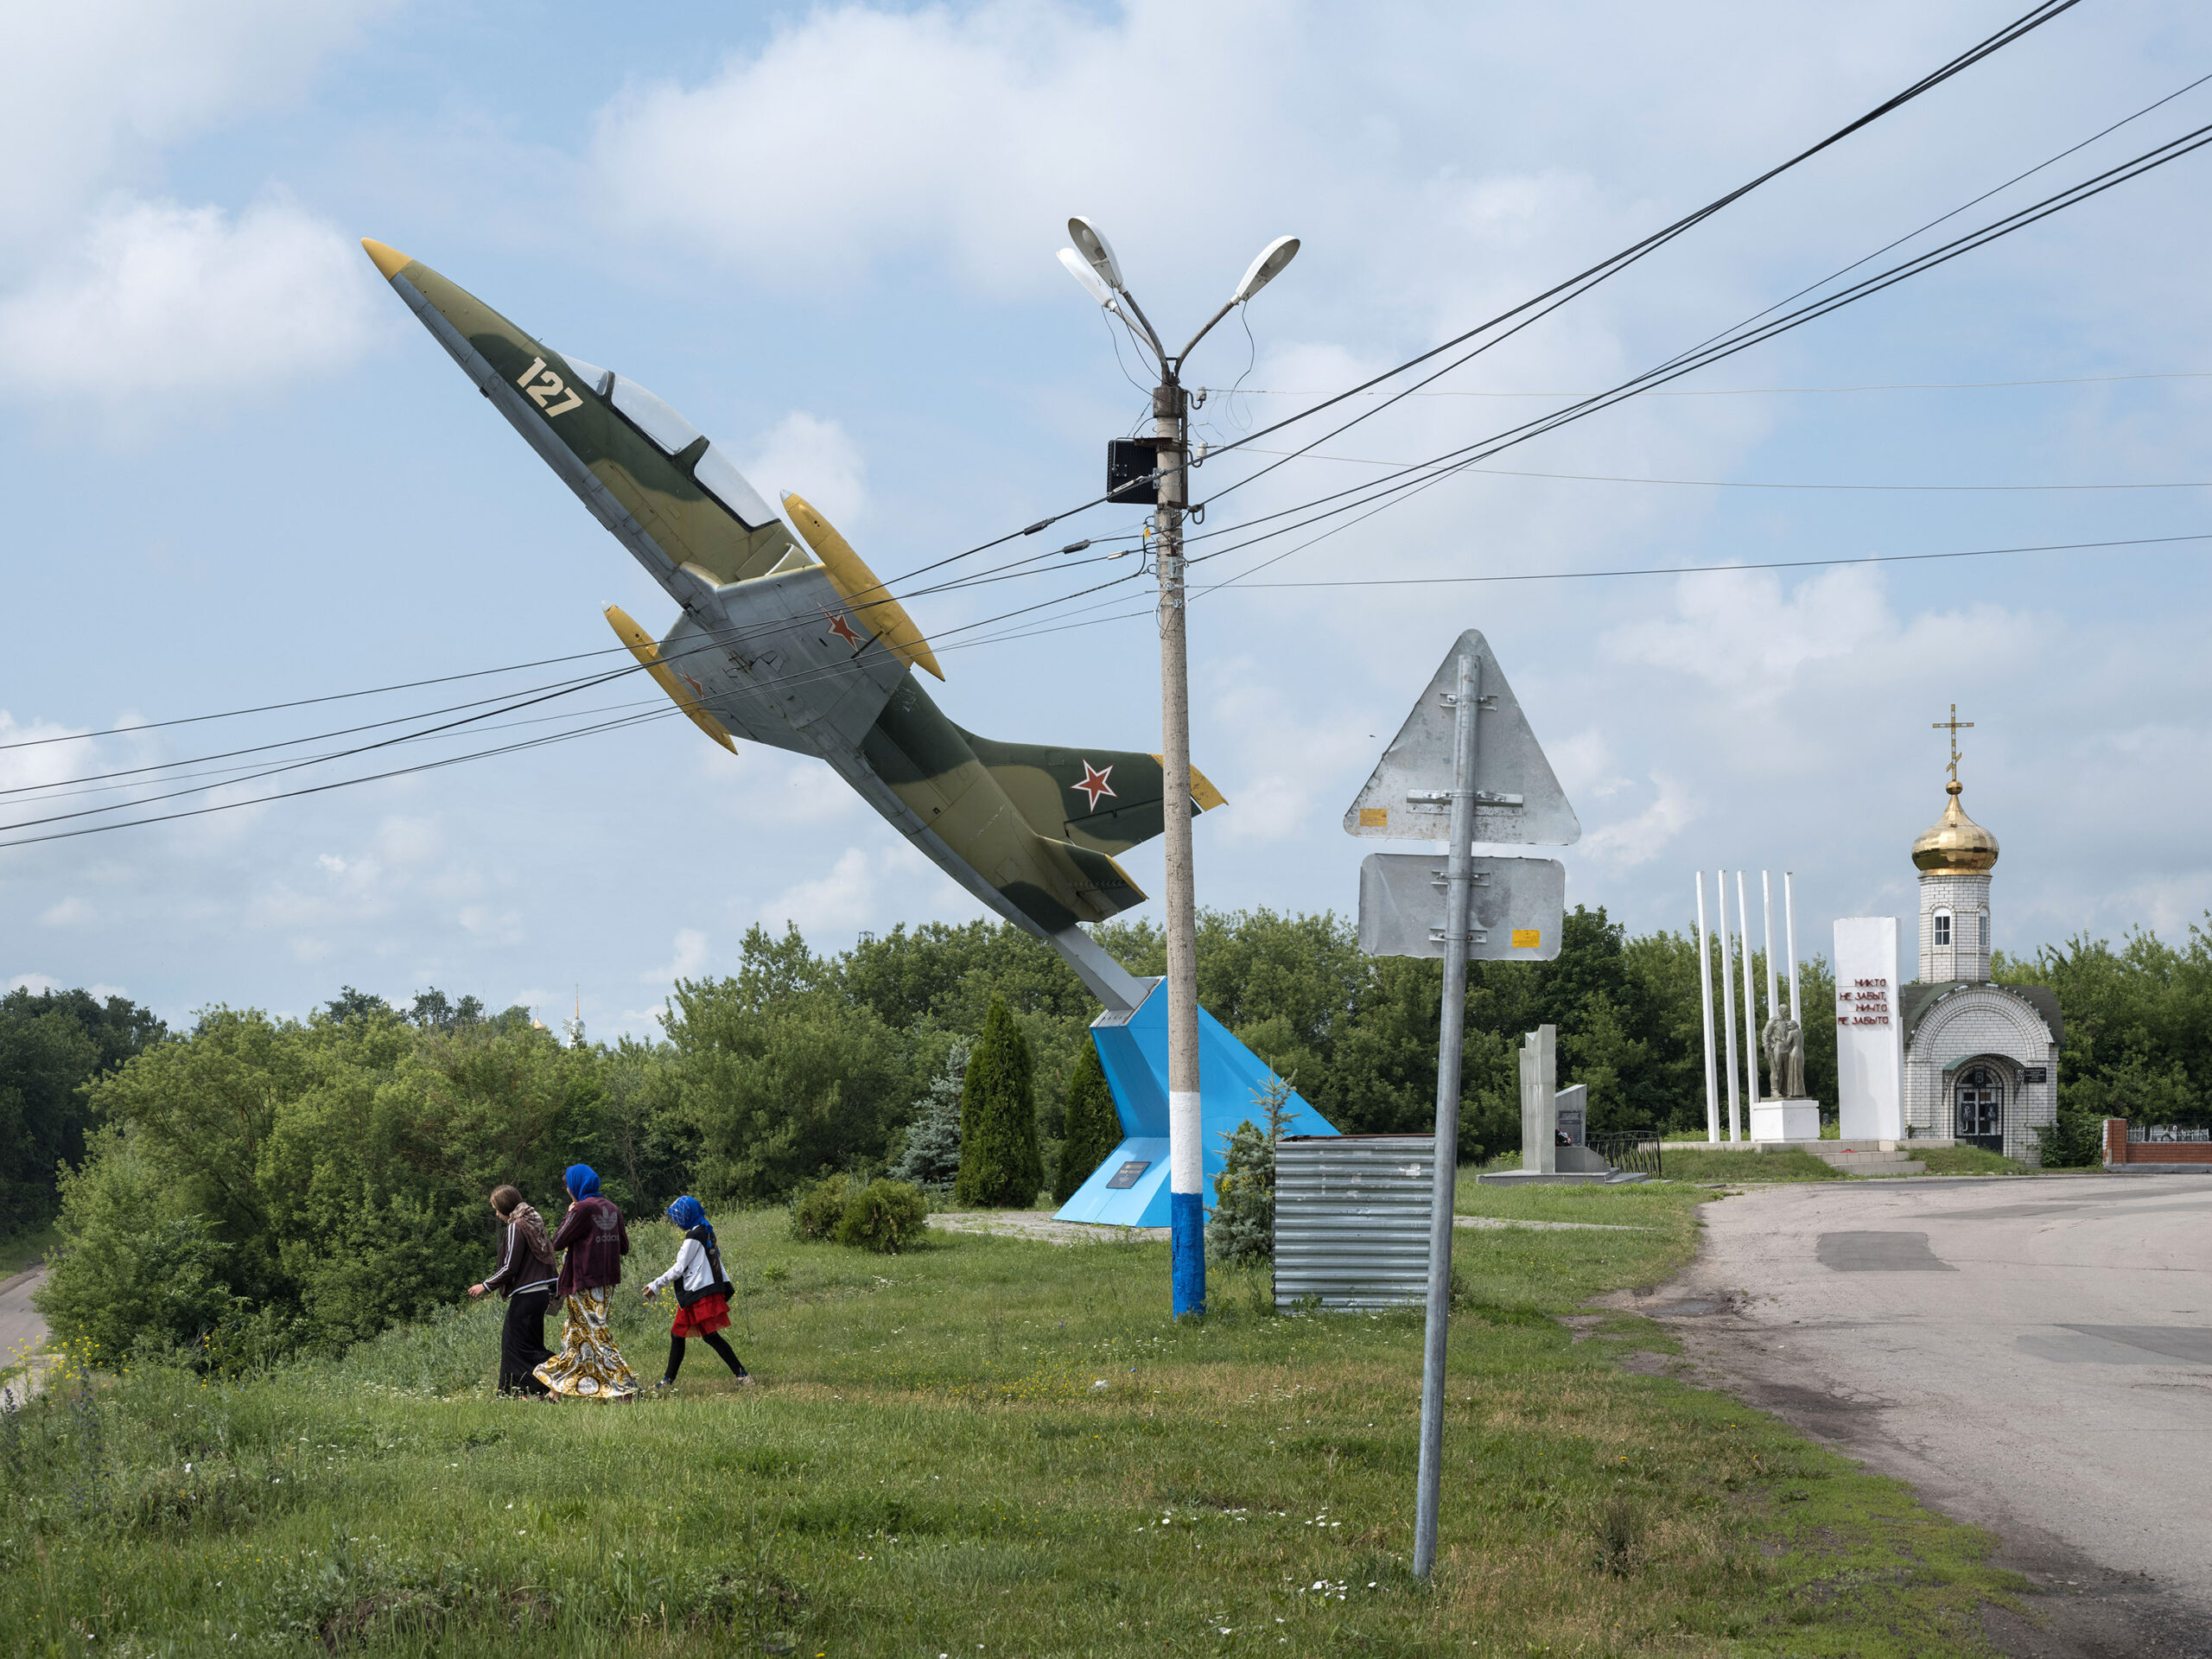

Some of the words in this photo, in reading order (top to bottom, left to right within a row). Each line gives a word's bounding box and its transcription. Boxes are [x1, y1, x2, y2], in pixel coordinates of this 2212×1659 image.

[517, 356, 584, 417] 127
[1854, 978, 1886, 987] НИКТО
[1840, 992, 1852, 1001] НЕ
[1854, 991, 1886, 1001] ЗАБЫТ,
[1855, 1003, 1887, 1012] НИЧТО
[1852, 1016, 1889, 1025] ЗАБЫТО
[595, 1232, 620, 1243] adda
